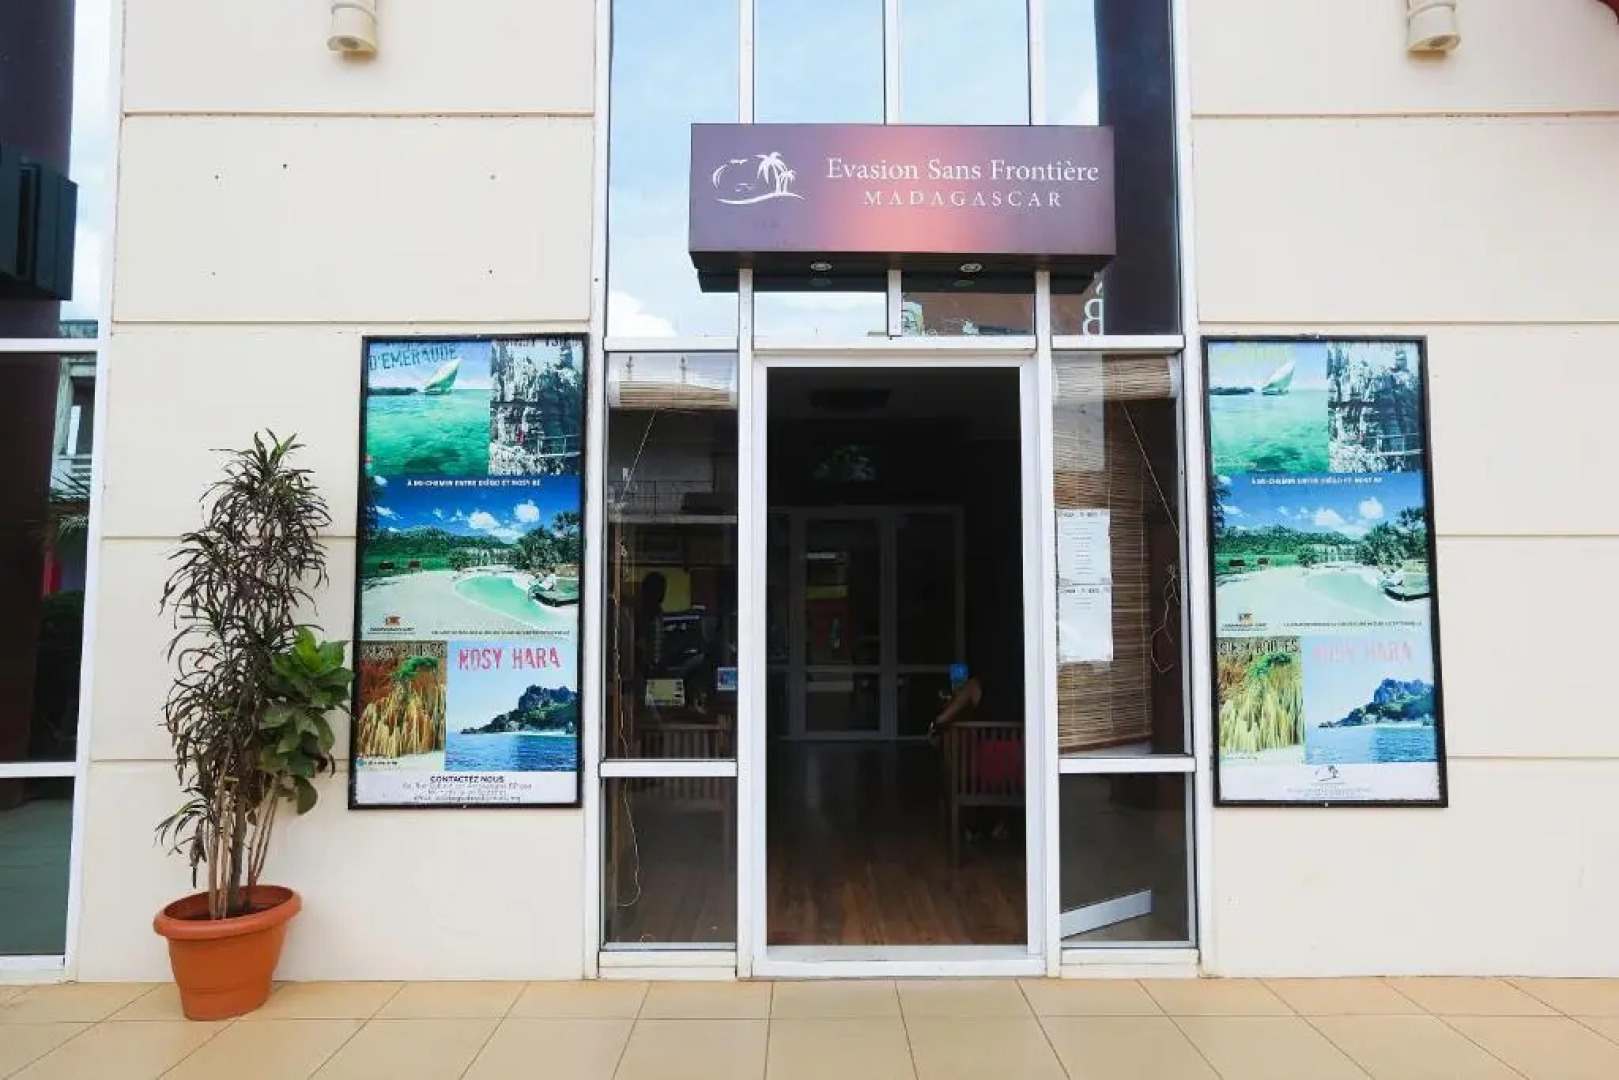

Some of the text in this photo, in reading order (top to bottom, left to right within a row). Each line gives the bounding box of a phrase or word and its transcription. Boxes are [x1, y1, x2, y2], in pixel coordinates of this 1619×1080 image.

[827, 157, 1099, 182] Evasion Sans Frontière
[863, 189, 1062, 208] MADAGASCAR
[458, 647, 504, 671] NOSY
[512, 646, 561, 670] HARA
[480, 775, 505, 783] NOUS
